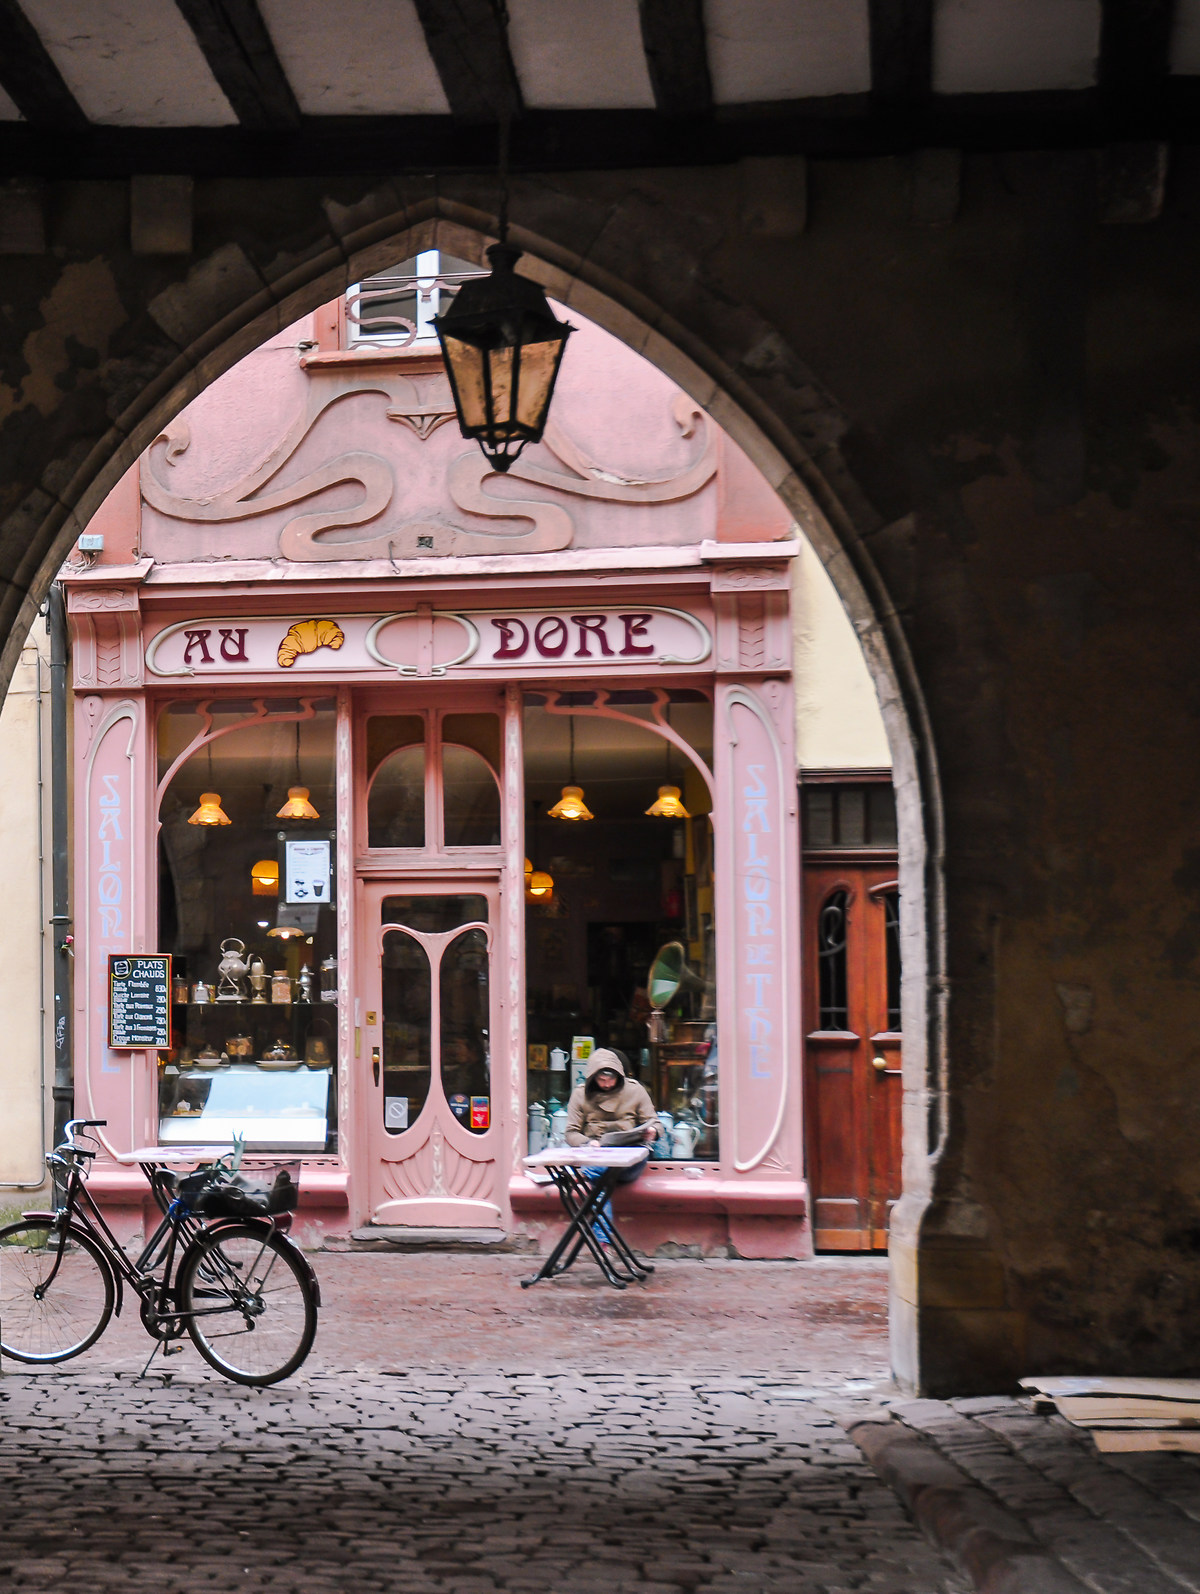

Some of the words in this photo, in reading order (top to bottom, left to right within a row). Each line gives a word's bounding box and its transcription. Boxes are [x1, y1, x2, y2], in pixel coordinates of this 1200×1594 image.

[184, 628, 249, 664] AU
[491, 614, 655, 659] DORE
[98, 775, 125, 938] SALON
[743, 764, 774, 937] SALON
[132, 970, 166, 979] CHAUDS
[137, 960, 164, 970] PLATS
